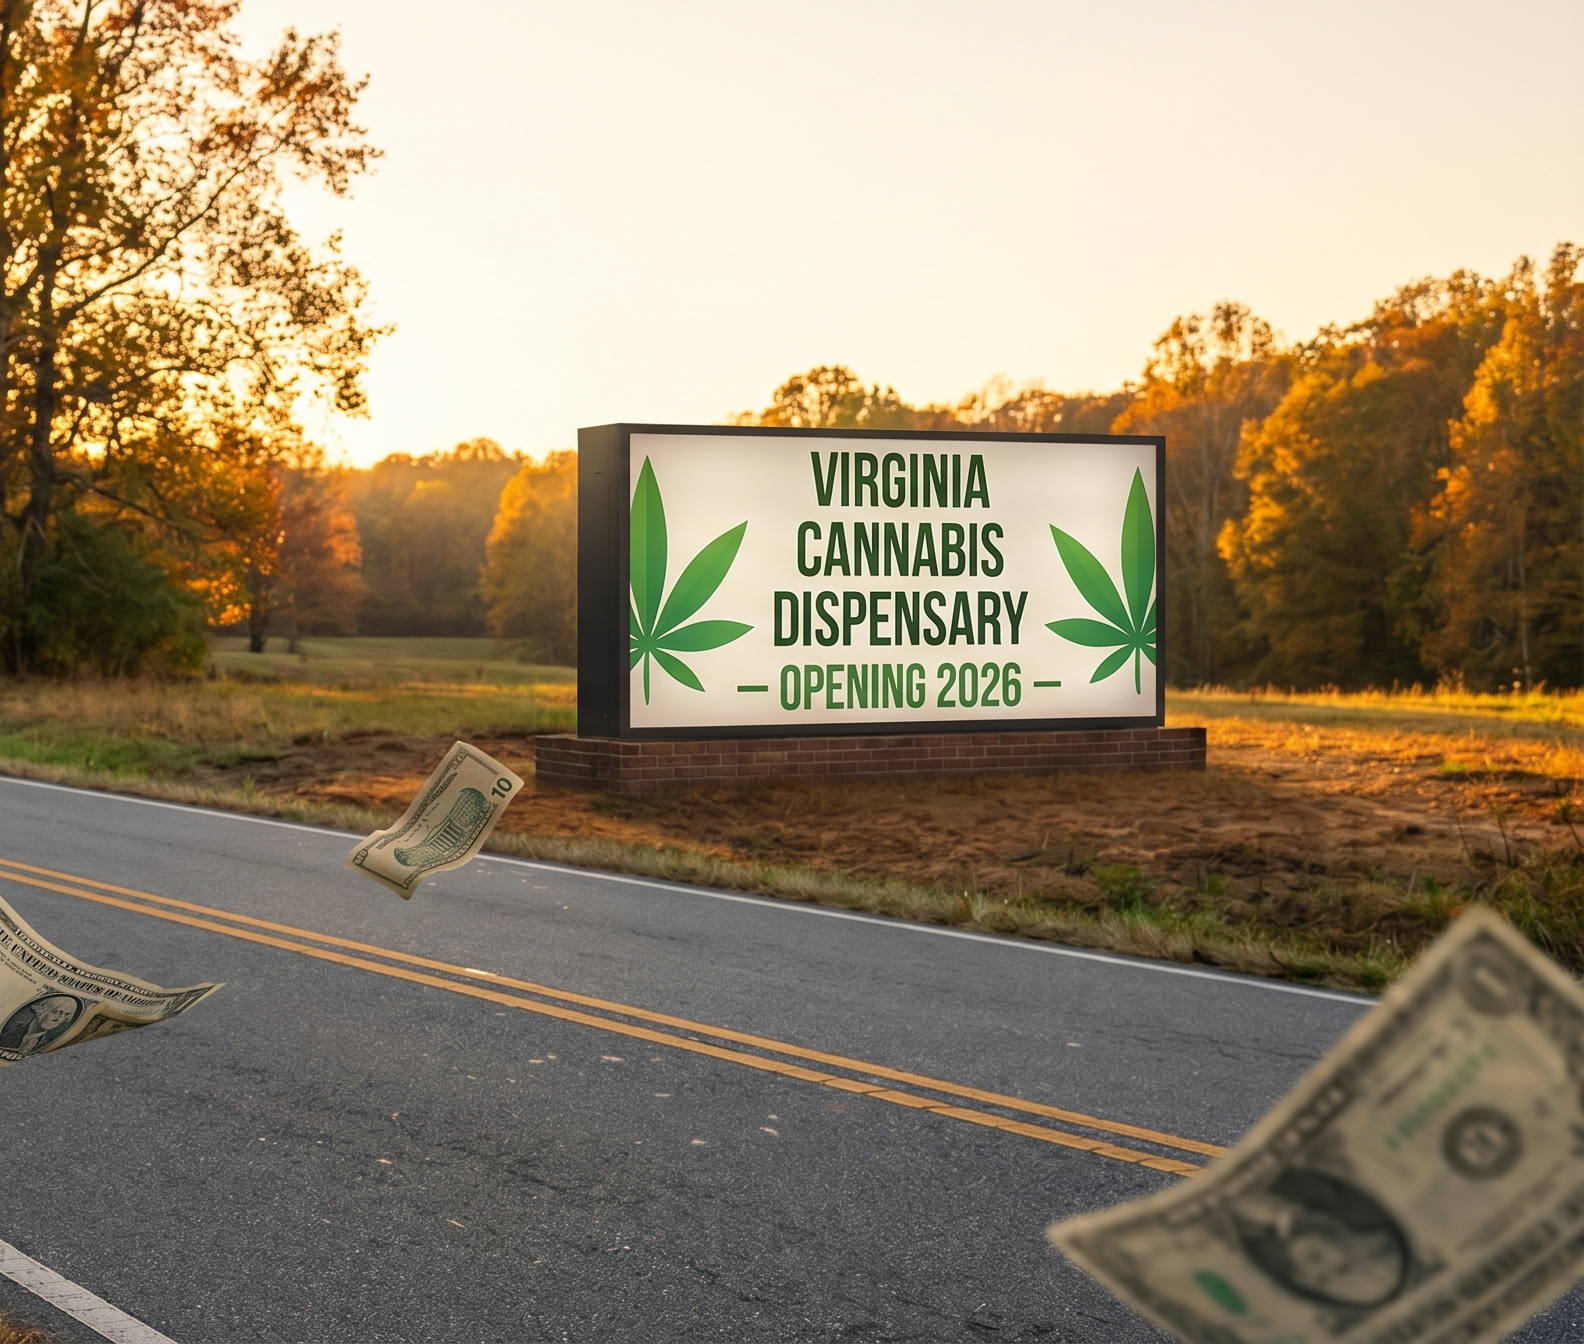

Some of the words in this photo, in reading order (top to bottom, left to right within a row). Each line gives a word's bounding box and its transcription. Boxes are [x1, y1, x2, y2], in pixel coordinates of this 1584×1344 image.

[810, 451, 991, 508] VIRGINIA
[797, 520, 1004, 578] CANNABIS
[773, 591, 1029, 647] DISPENSARY
[780, 662, 926, 711] OPENING
[937, 662, 1022, 708] 2026
[491, 777, 513, 799] 10
